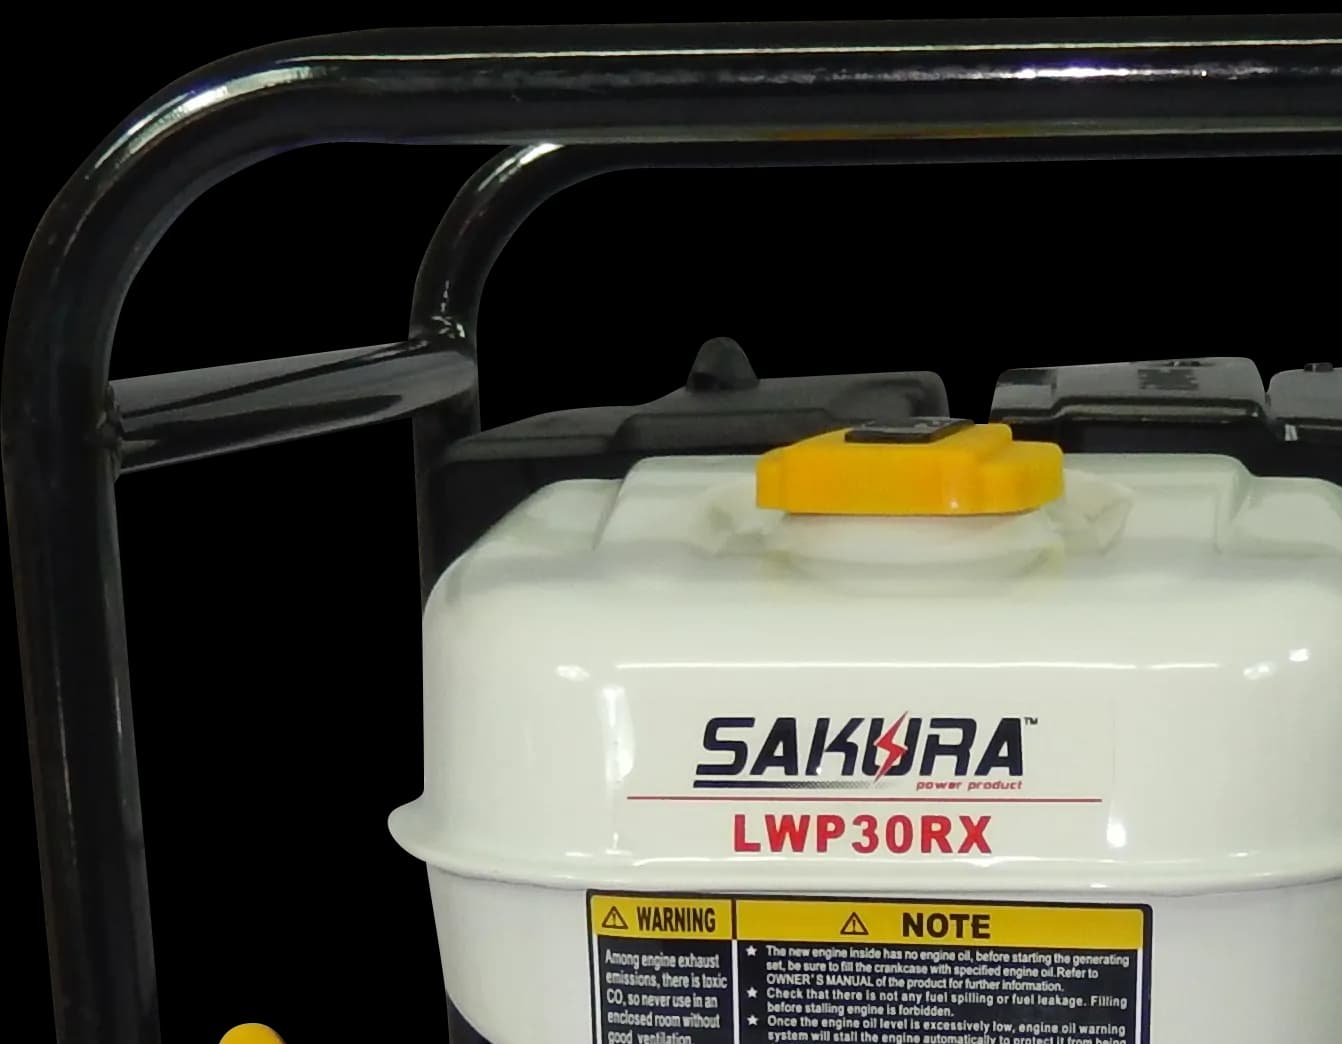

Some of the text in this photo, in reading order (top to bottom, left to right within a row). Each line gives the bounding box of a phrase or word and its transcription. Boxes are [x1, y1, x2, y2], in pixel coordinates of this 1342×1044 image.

[695, 715, 1023, 777] SAKURA
[915, 779, 1023, 792] power product
[733, 814, 992, 854] LWP30RX
[637, 906, 716, 933] WARNING
[902, 912, 991, 939] NOTE
[605, 949, 720, 971] Among engine exhaust
[765, 945, 1130, 967] The new engine inside has no engine oil, before starting the generating
[605, 970, 728, 989] emissions, there is toxic
[766, 961, 786, 972] set,
[787, 961, 801, 971] be
[803, 962, 827, 972] sure
[828, 962, 839, 972] to
[840, 961, 853, 972] fill
[855, 962, 873, 973] the
[874, 962, 928, 974] crankcase
[930, 963, 951, 974] with
[953, 965, 1001, 979] specified
[1003, 966, 1039, 979] engine
[1088, 967, 1099, 978] to
[826, 975, 874, 987] MANUAL
[875, 976, 887, 987] of
[888, 976, 905, 988] the
[906, 978, 947, 990] product
[949, 978, 963, 989] for
[964, 979, 1000, 991] further
[1002, 979, 1065, 992] information.
[607, 988, 718, 1009] CO, so never use in an
[766, 987, 1128, 1009] Check that there is not any fuel spilling or fuel leakage. Filling
[607, 1009, 720, 1028] enclosed room without
[767, 1002, 954, 1017] before stalling engine is forbidden.
[767, 1015, 1126, 1037] Once the engine oil level is excessively low, engine oil warning
[767, 1031, 809, 1043] system
[811, 1031, 831, 1042] will
[833, 1031, 858, 1042] stall
[860, 1032, 879, 1043] the
[881, 1033, 920, 1044] engine
